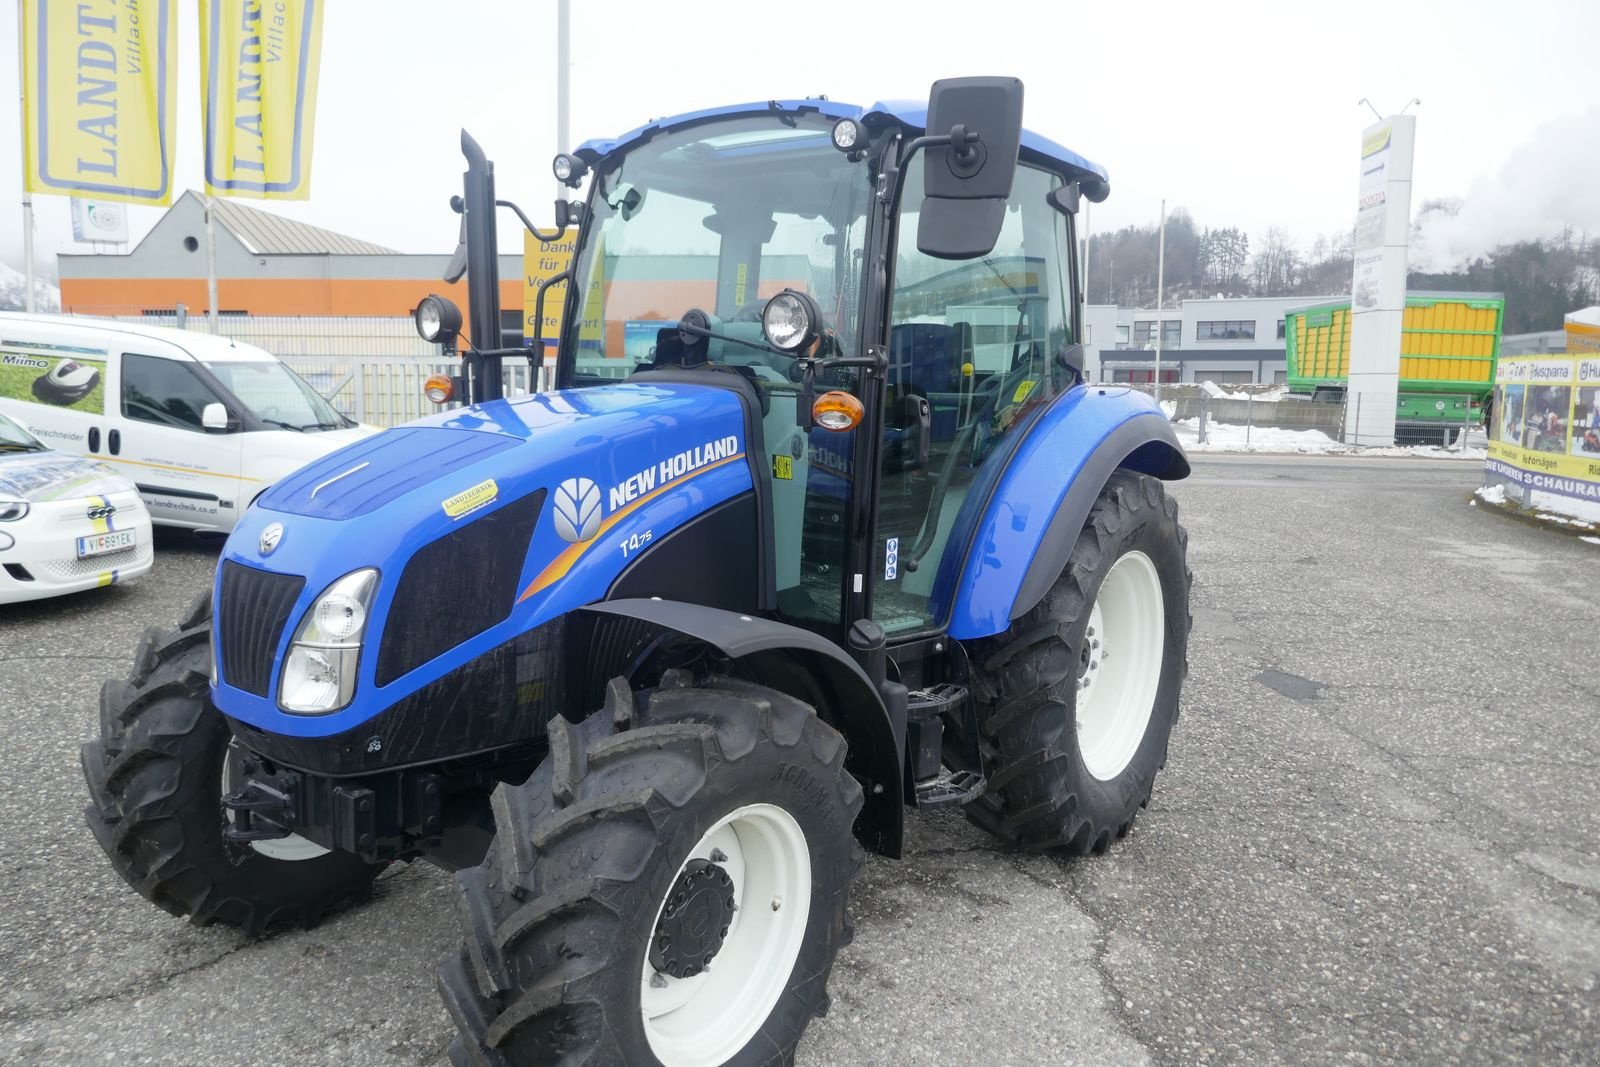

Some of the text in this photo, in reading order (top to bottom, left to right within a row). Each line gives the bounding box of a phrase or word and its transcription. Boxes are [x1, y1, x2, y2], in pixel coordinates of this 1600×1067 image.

[77, 0, 118, 178] LANDT
[540, 241, 576, 253] Dank
[538, 257, 559, 271] für
[527, 315, 558, 327] Gte
[609, 465, 657, 512] NEW
[659, 435, 738, 484] HOLLAND
[619, 529, 653, 558] T4.75
